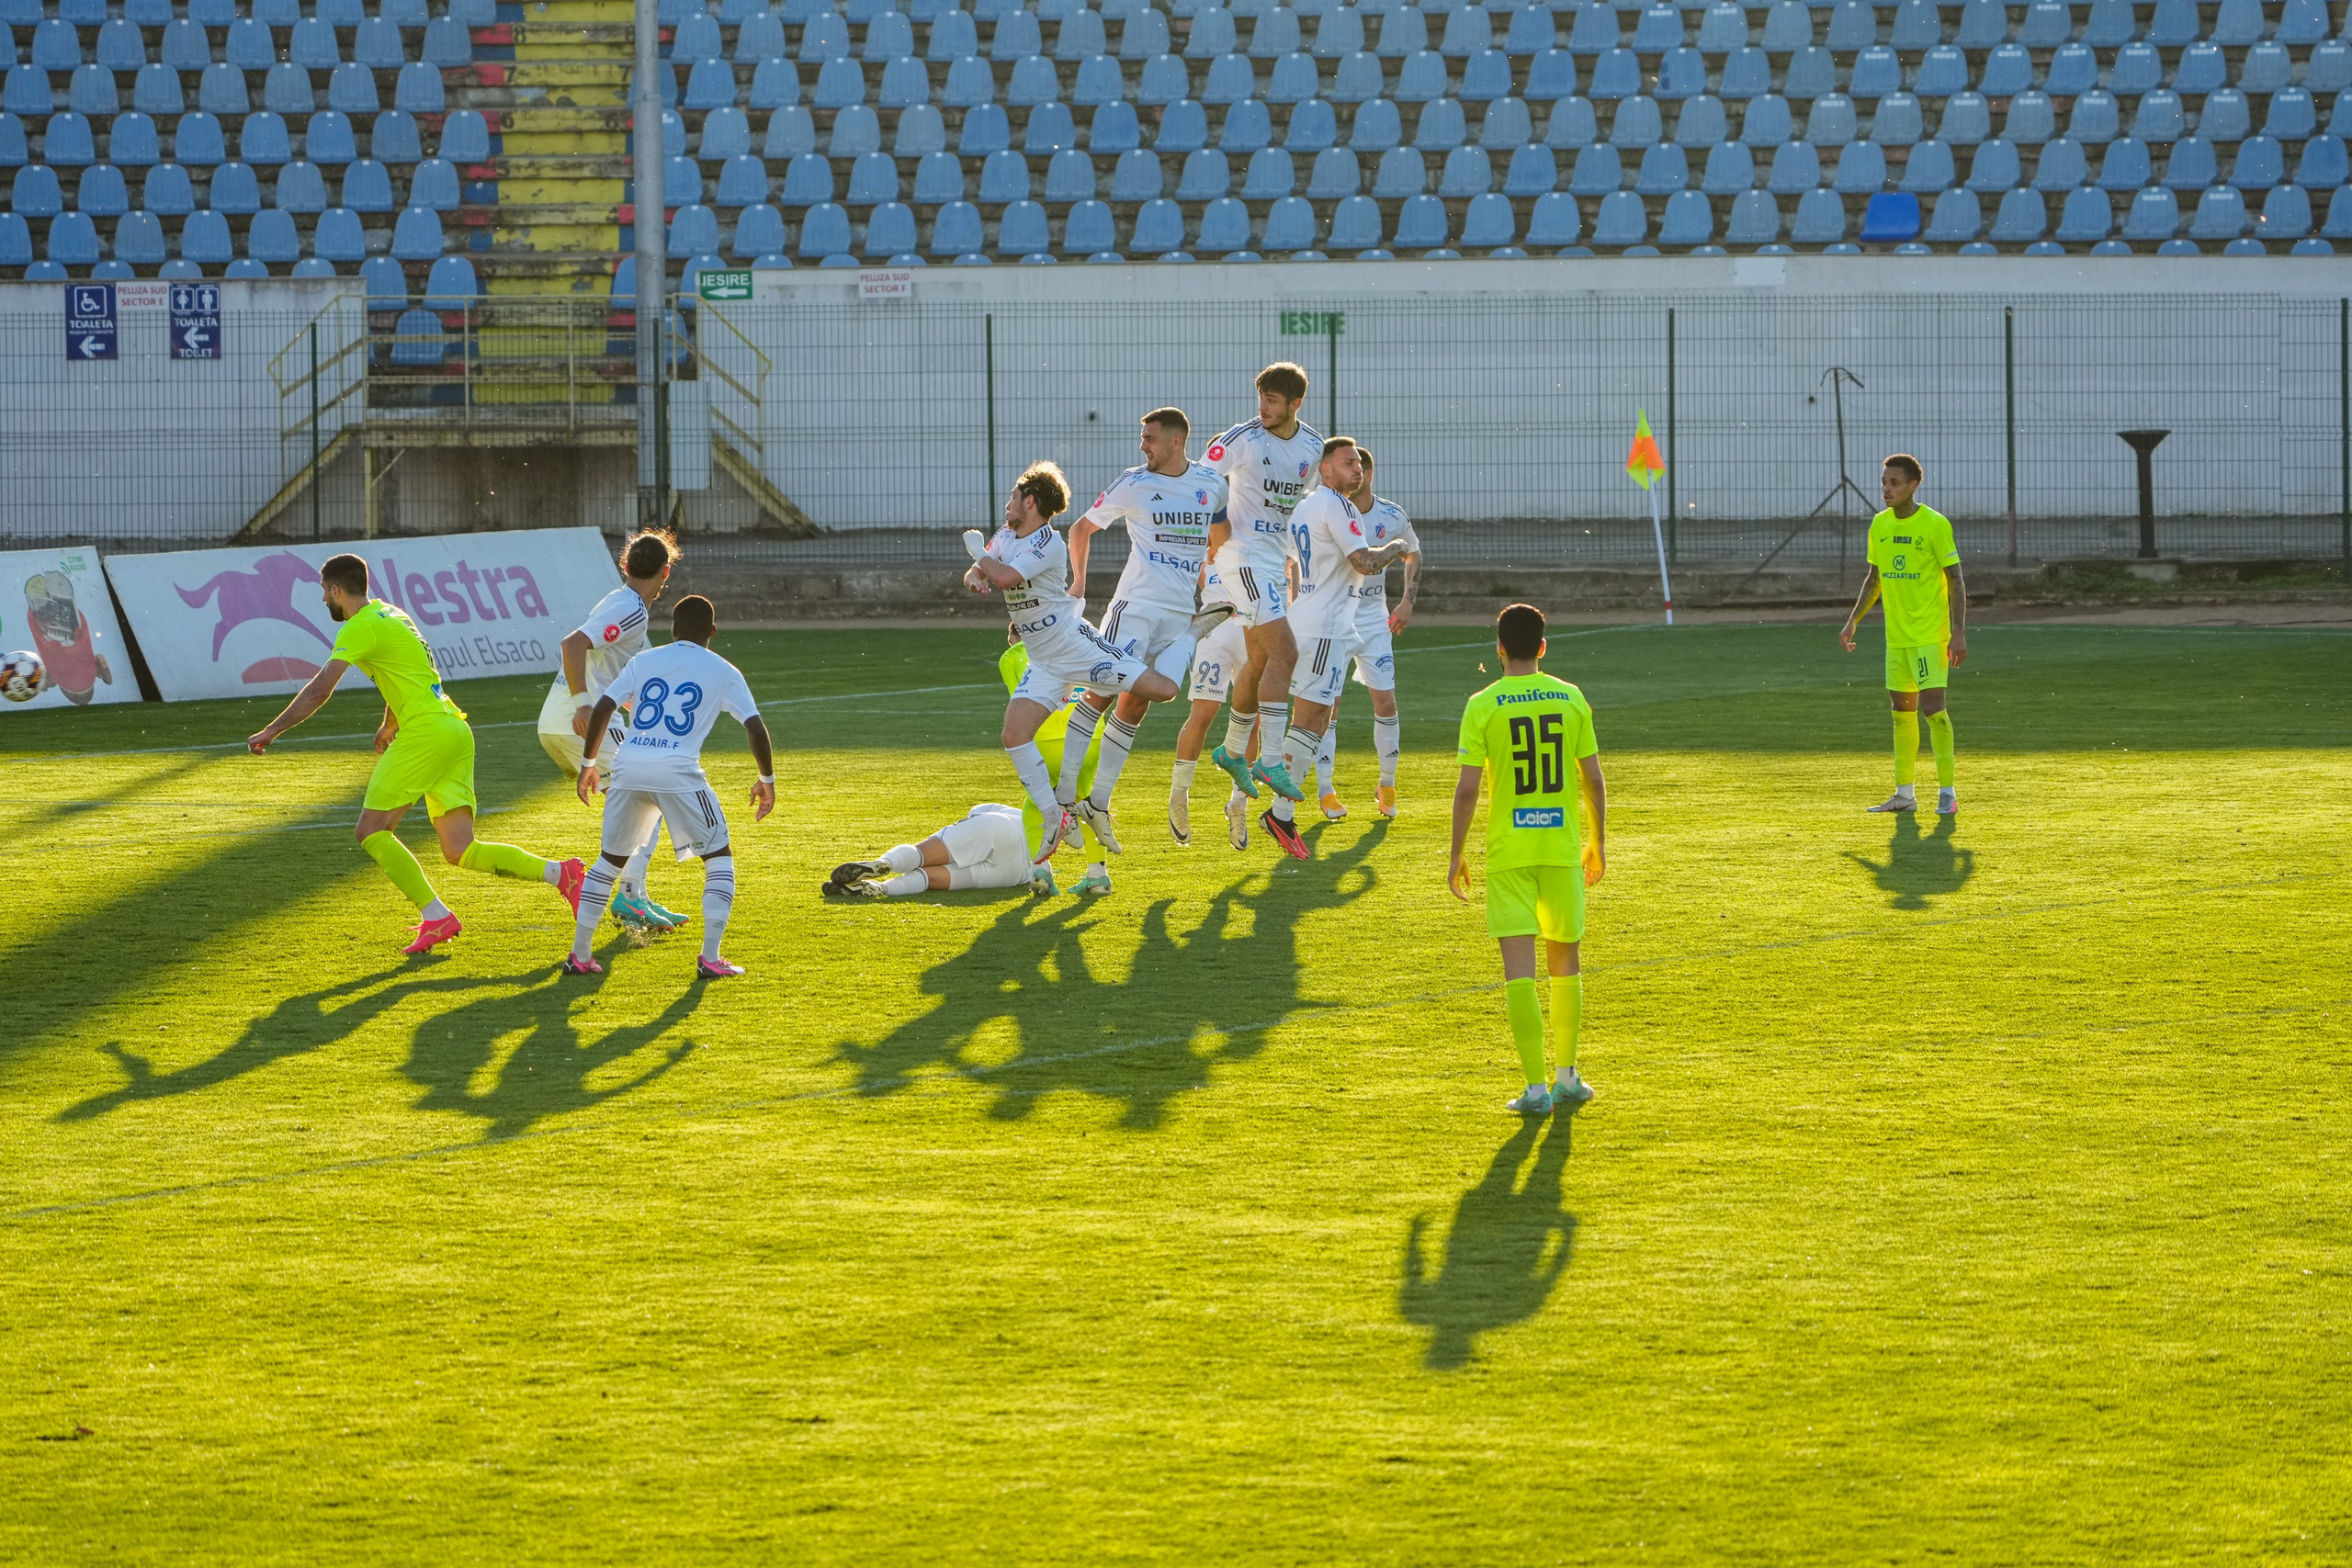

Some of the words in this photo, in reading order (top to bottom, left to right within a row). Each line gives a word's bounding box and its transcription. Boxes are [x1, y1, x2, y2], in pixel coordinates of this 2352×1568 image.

[860, 273, 891, 282] PELUZA
[892, 273, 910, 282] SUD
[118, 286, 149, 295] PELUZA
[150, 286, 167, 295] SUD
[864, 285, 899, 293] SECTOR
[121, 298, 157, 306] SECTOR
[159, 298, 164, 306] E
[69, 320, 114, 329] TOALETA
[175, 317, 218, 327] TOALETA
[179, 348, 213, 357] TOILET
[1152, 512, 1211, 526] UNIBET
[368, 558, 549, 626] Vestra
[1014, 615, 1057, 634] SACO
[432, 637, 477, 677] upul
[473, 635, 546, 666] Elsaco
[1199, 661, 1220, 685] 93
[1496, 688, 1570, 706] Panifcom
[633, 677, 703, 737] 83
[629, 737, 671, 749] ALDAIR.
[1509, 713, 1564, 795] 35
